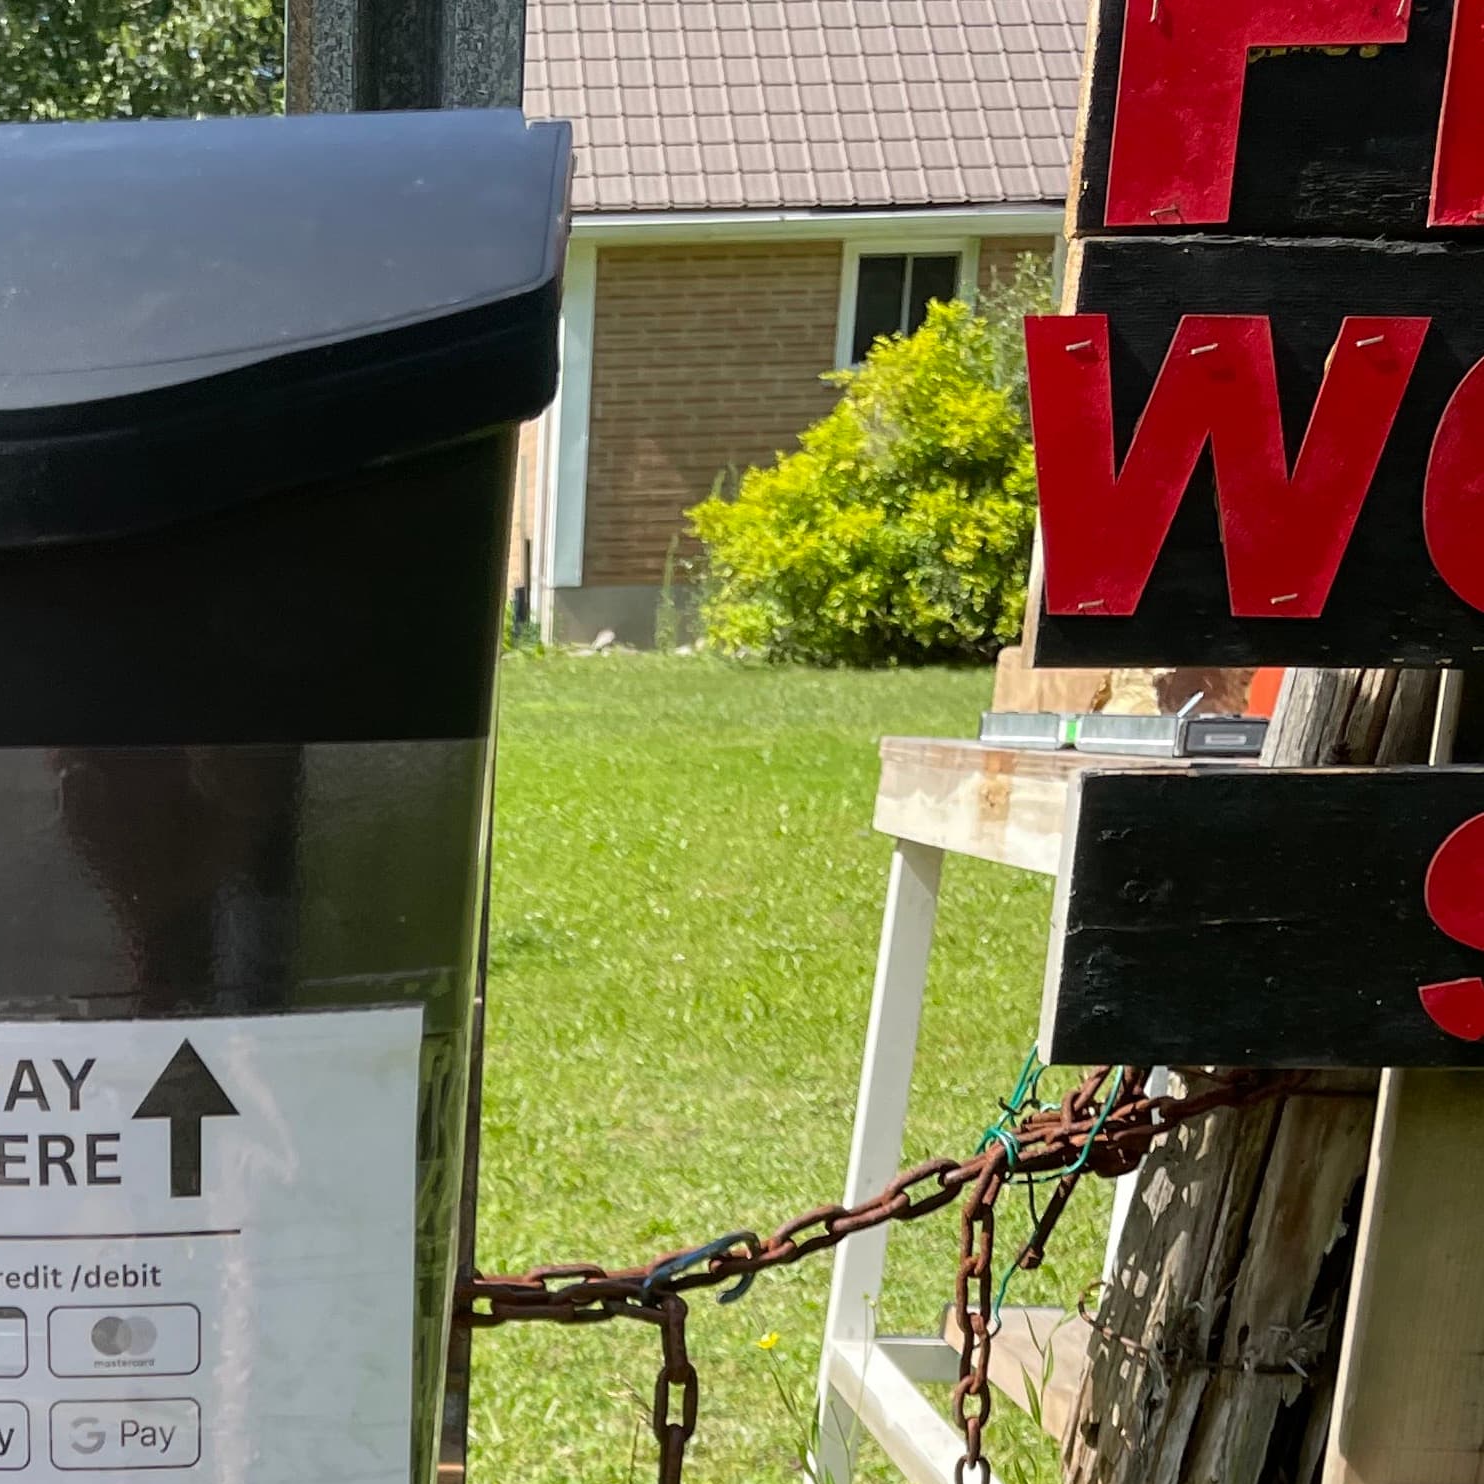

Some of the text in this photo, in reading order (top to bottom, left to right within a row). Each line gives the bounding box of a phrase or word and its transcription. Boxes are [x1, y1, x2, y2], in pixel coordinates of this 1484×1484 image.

[1104, 0, 1484, 227] F
[70, 1264, 162, 1292] /debit
[93, 1358, 156, 1368] mastercard
[120, 1420, 177, 1454] Pay
